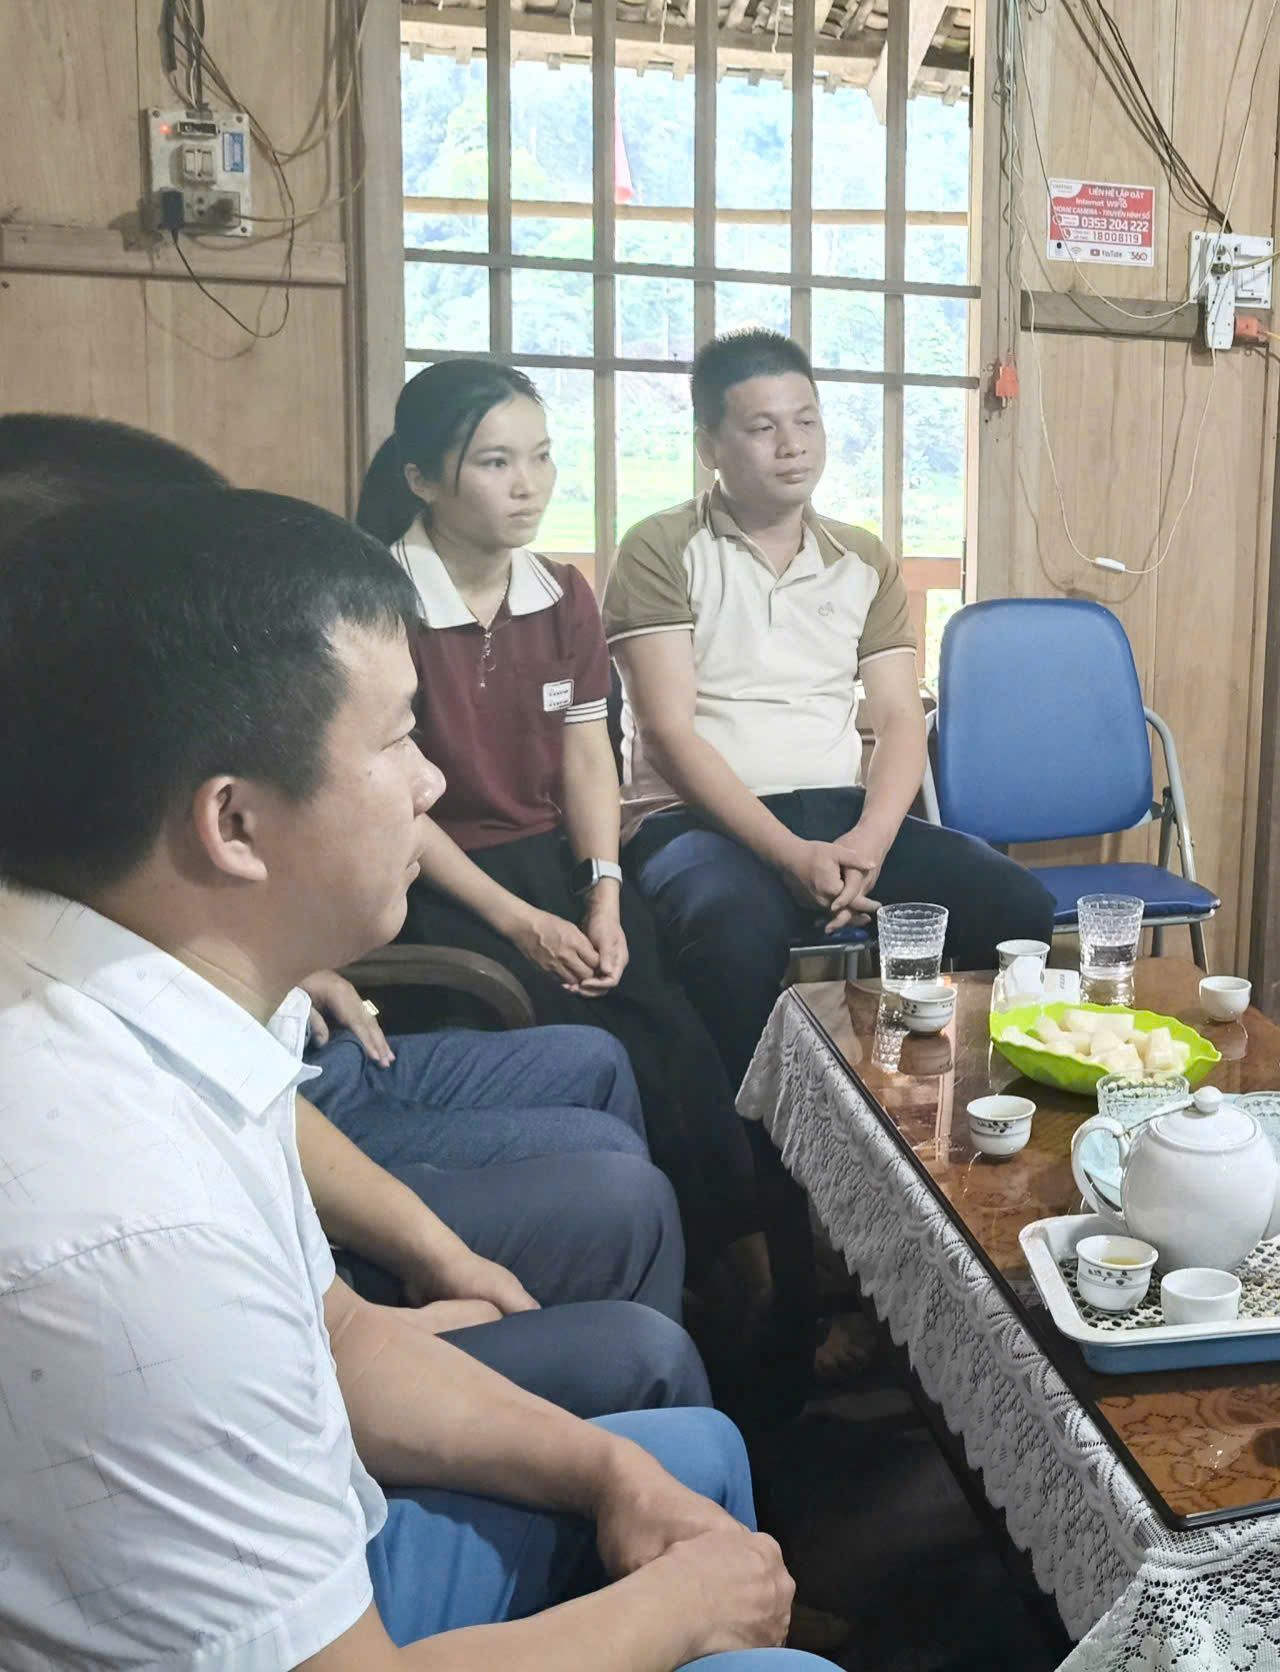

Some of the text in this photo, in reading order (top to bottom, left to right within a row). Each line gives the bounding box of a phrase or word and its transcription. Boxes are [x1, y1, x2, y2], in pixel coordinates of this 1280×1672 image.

[1081, 216, 1149, 232] 0353 204 222
